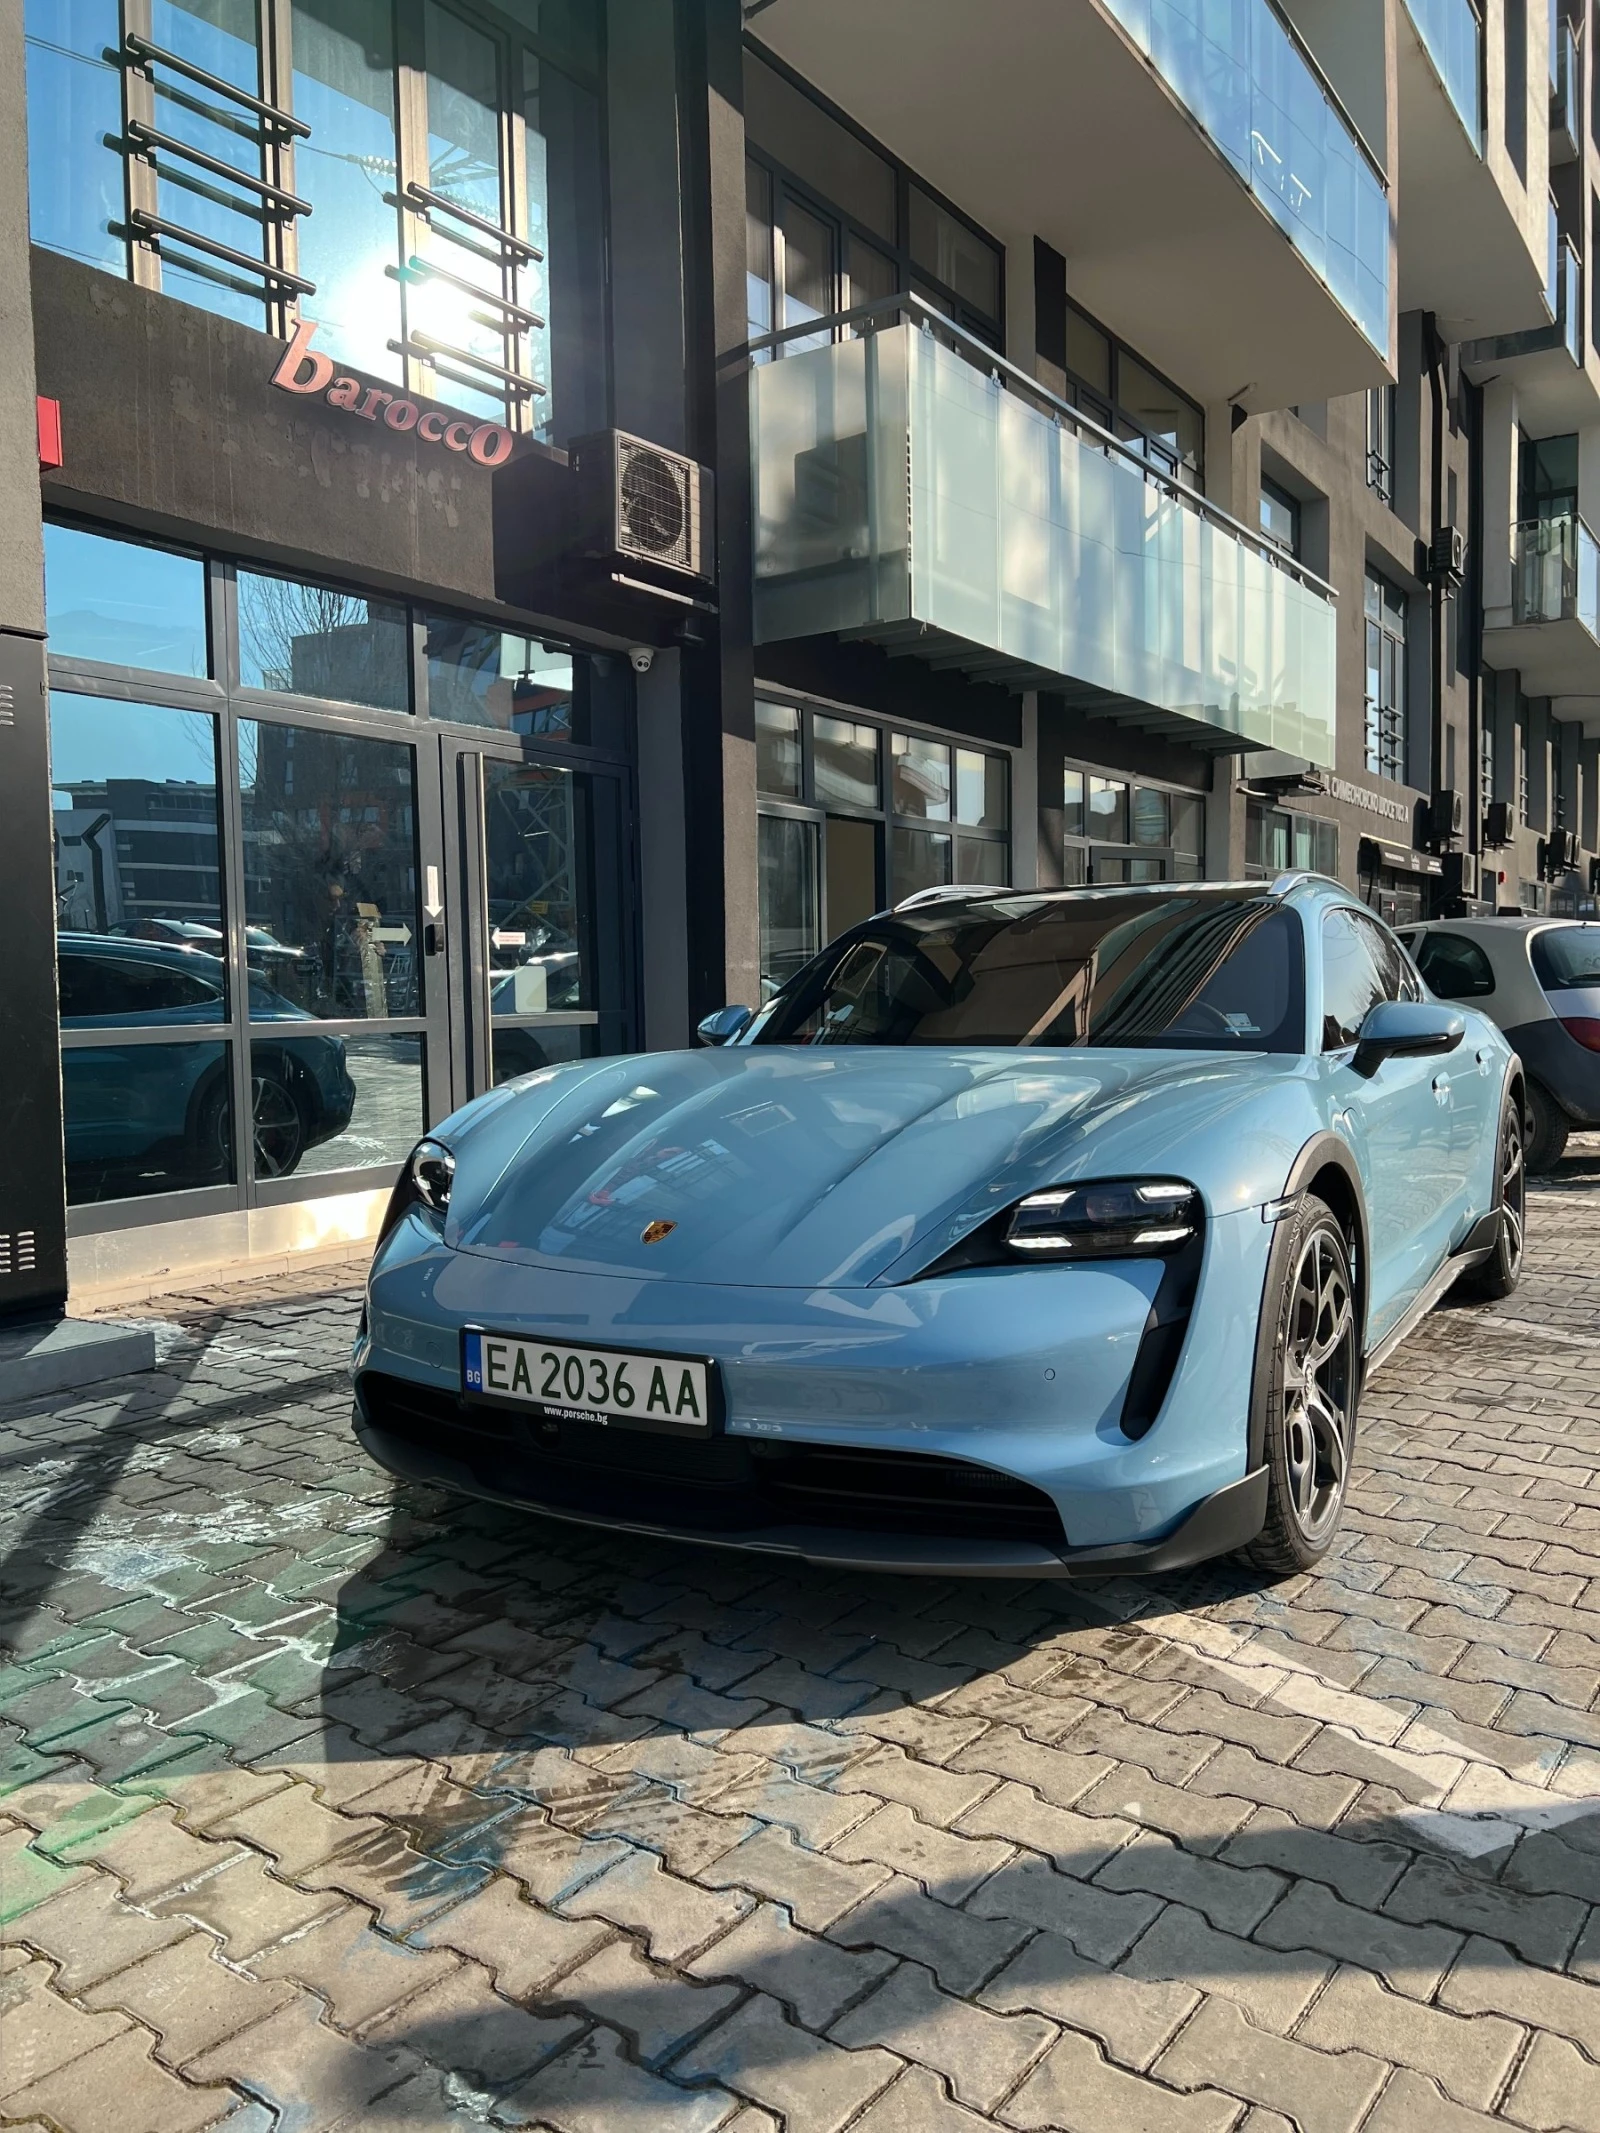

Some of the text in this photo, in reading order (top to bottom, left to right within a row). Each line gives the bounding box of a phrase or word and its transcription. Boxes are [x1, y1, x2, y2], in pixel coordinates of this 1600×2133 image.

[1331, 777, 1379, 813] СИМЕОНОВСКО
[466, 1369, 481, 1384] BG
[540, 1352, 636, 1408] 2036
[543, 1405, 609, 1426] www.porsche.bg
